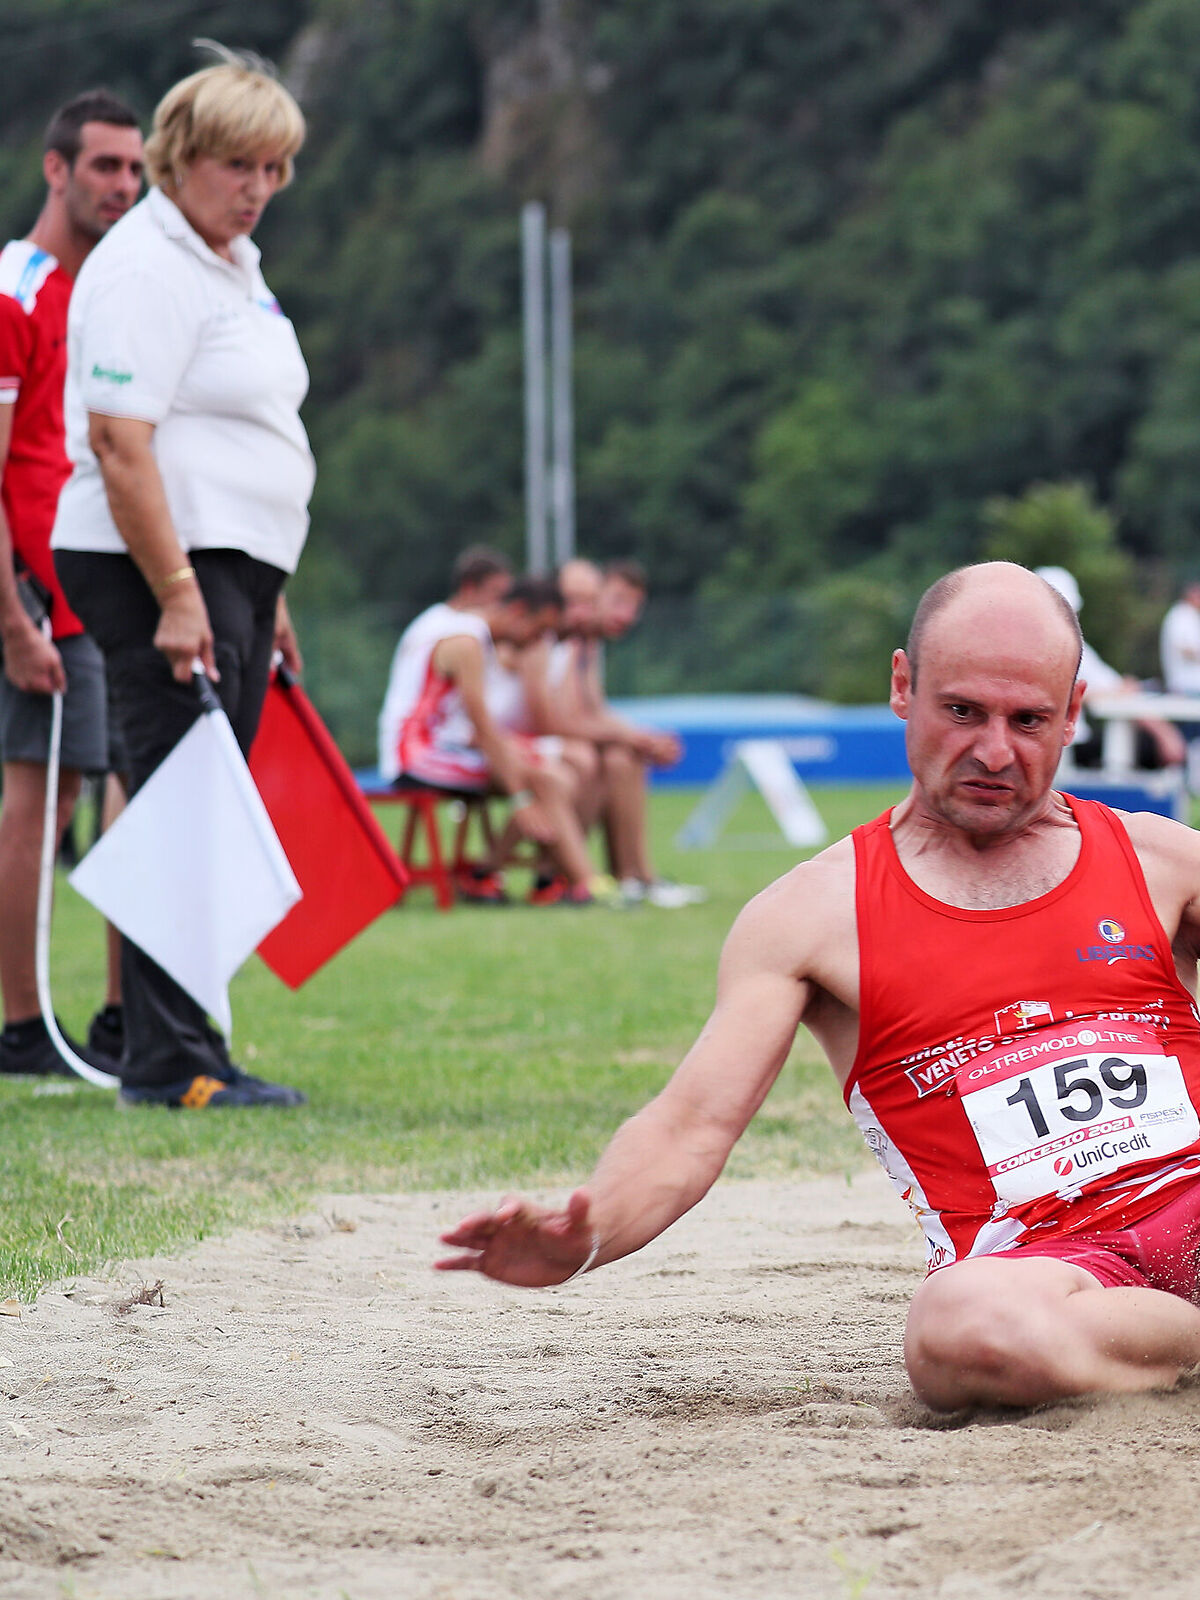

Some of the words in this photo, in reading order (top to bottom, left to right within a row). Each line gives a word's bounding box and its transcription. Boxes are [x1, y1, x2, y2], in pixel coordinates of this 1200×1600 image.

[1076, 944, 1155, 962] LIBERTAS
[918, 1040, 995, 1085] VENETO
[1006, 1057, 1148, 1138] 159
[996, 1130, 1085, 1173] CONCESIO
[1088, 1117, 1131, 1138] 2021
[1073, 1132, 1152, 1168] UniCredit
